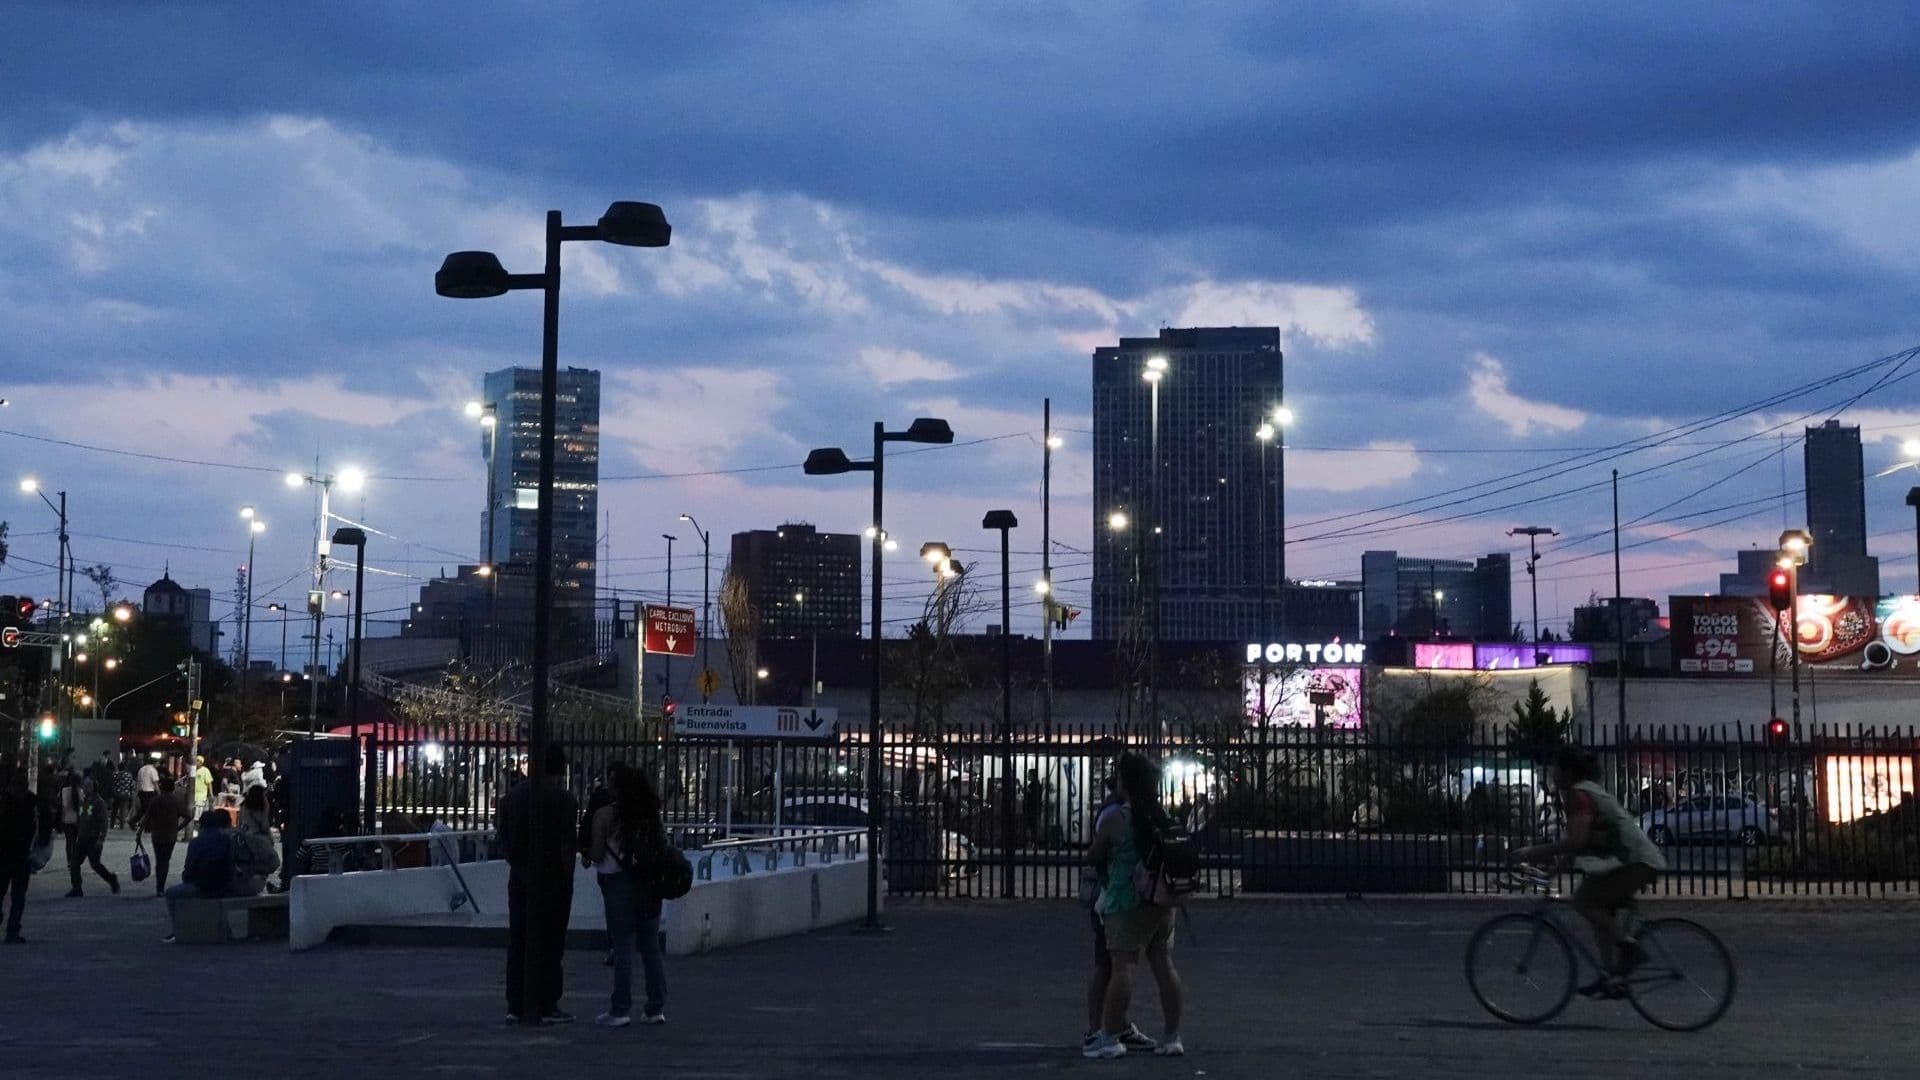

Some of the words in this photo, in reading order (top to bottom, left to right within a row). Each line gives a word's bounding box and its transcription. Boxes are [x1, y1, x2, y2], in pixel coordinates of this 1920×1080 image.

[1693, 614, 1738, 626] TODOS
[1693, 626, 1713, 635] LOS
[1247, 636, 1363, 663] PORTÓN
[1695, 639, 1738, 657] $94
[687, 706, 732, 717] Entrada:
[686, 719, 747, 731] Buenavista
